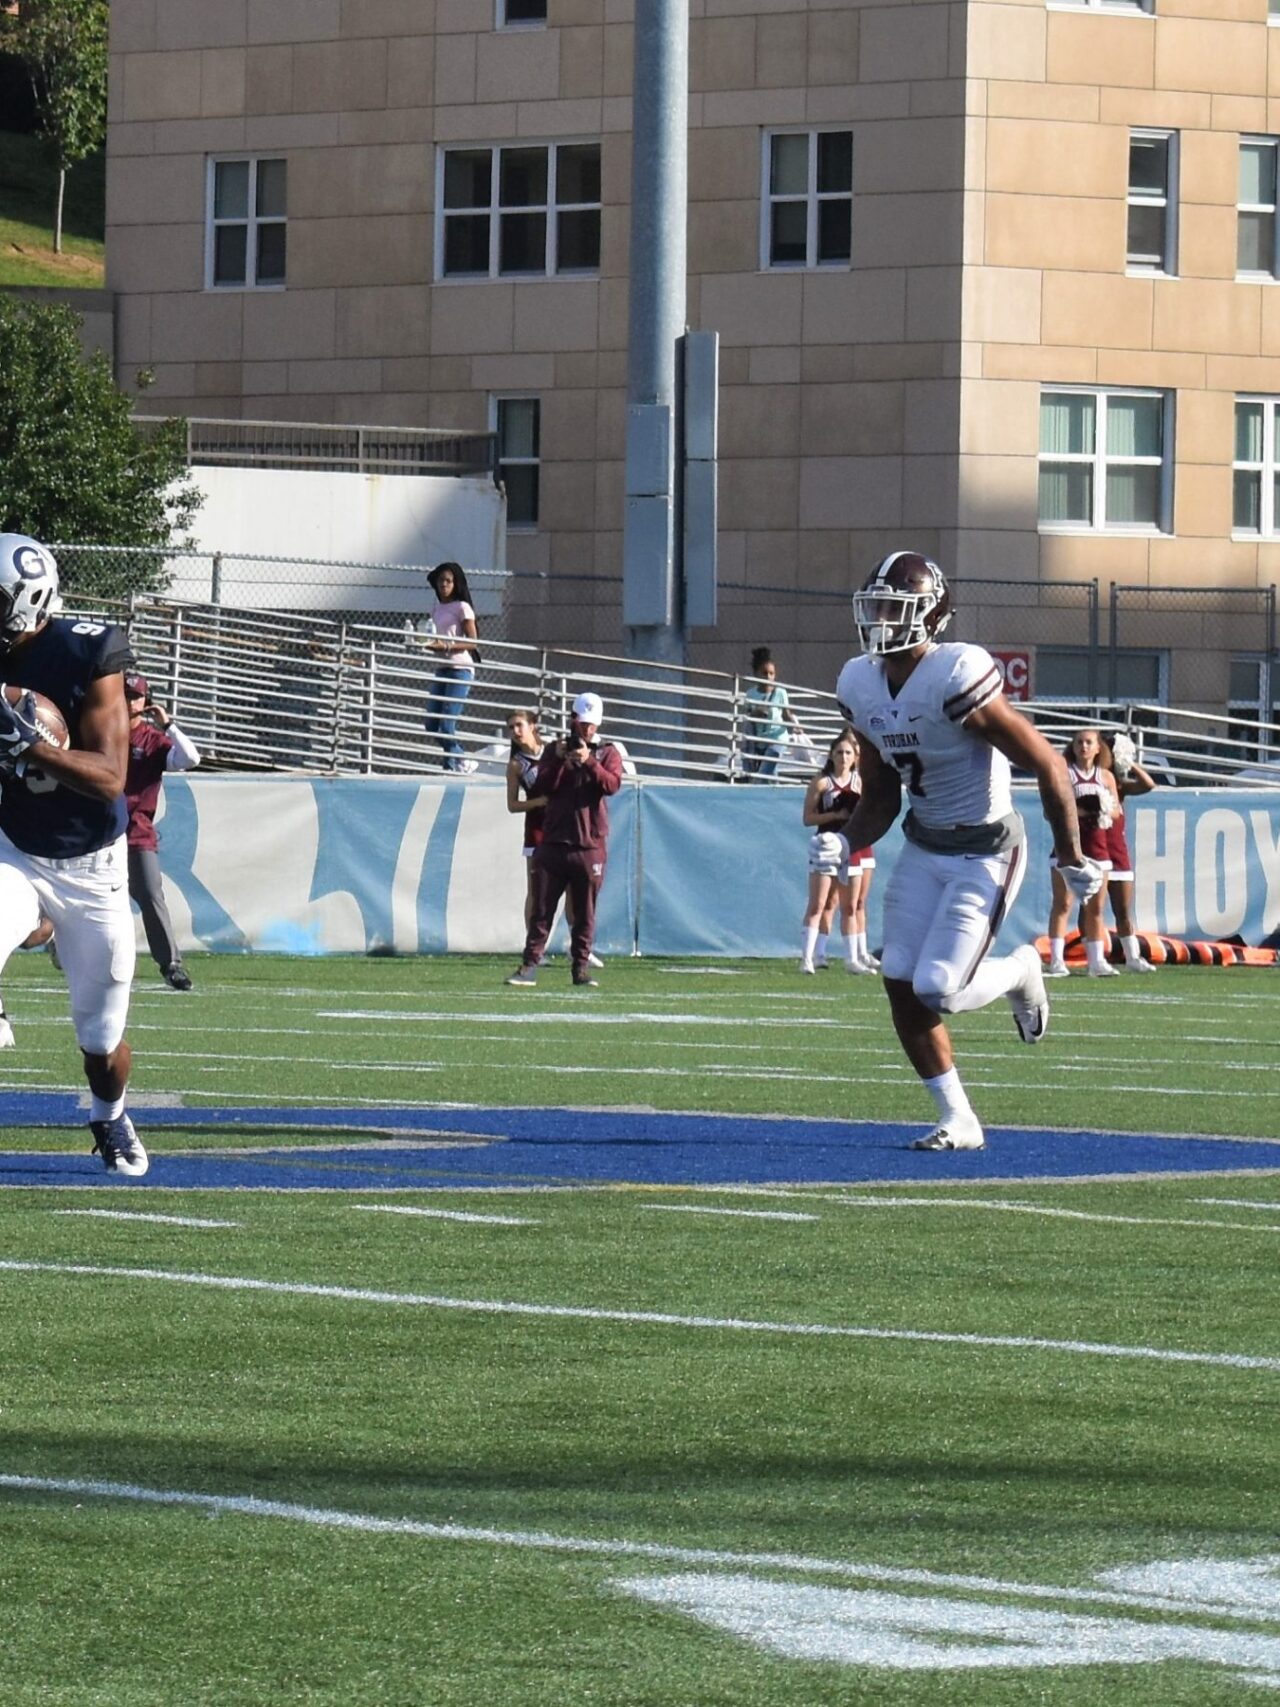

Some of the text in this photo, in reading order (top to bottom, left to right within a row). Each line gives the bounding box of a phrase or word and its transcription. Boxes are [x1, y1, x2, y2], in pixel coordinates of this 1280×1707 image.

[12, 546, 47, 580] G
[71, 622, 107, 637] 9
[882, 732, 921, 748] FORDHAM
[891, 751, 928, 797] 7
